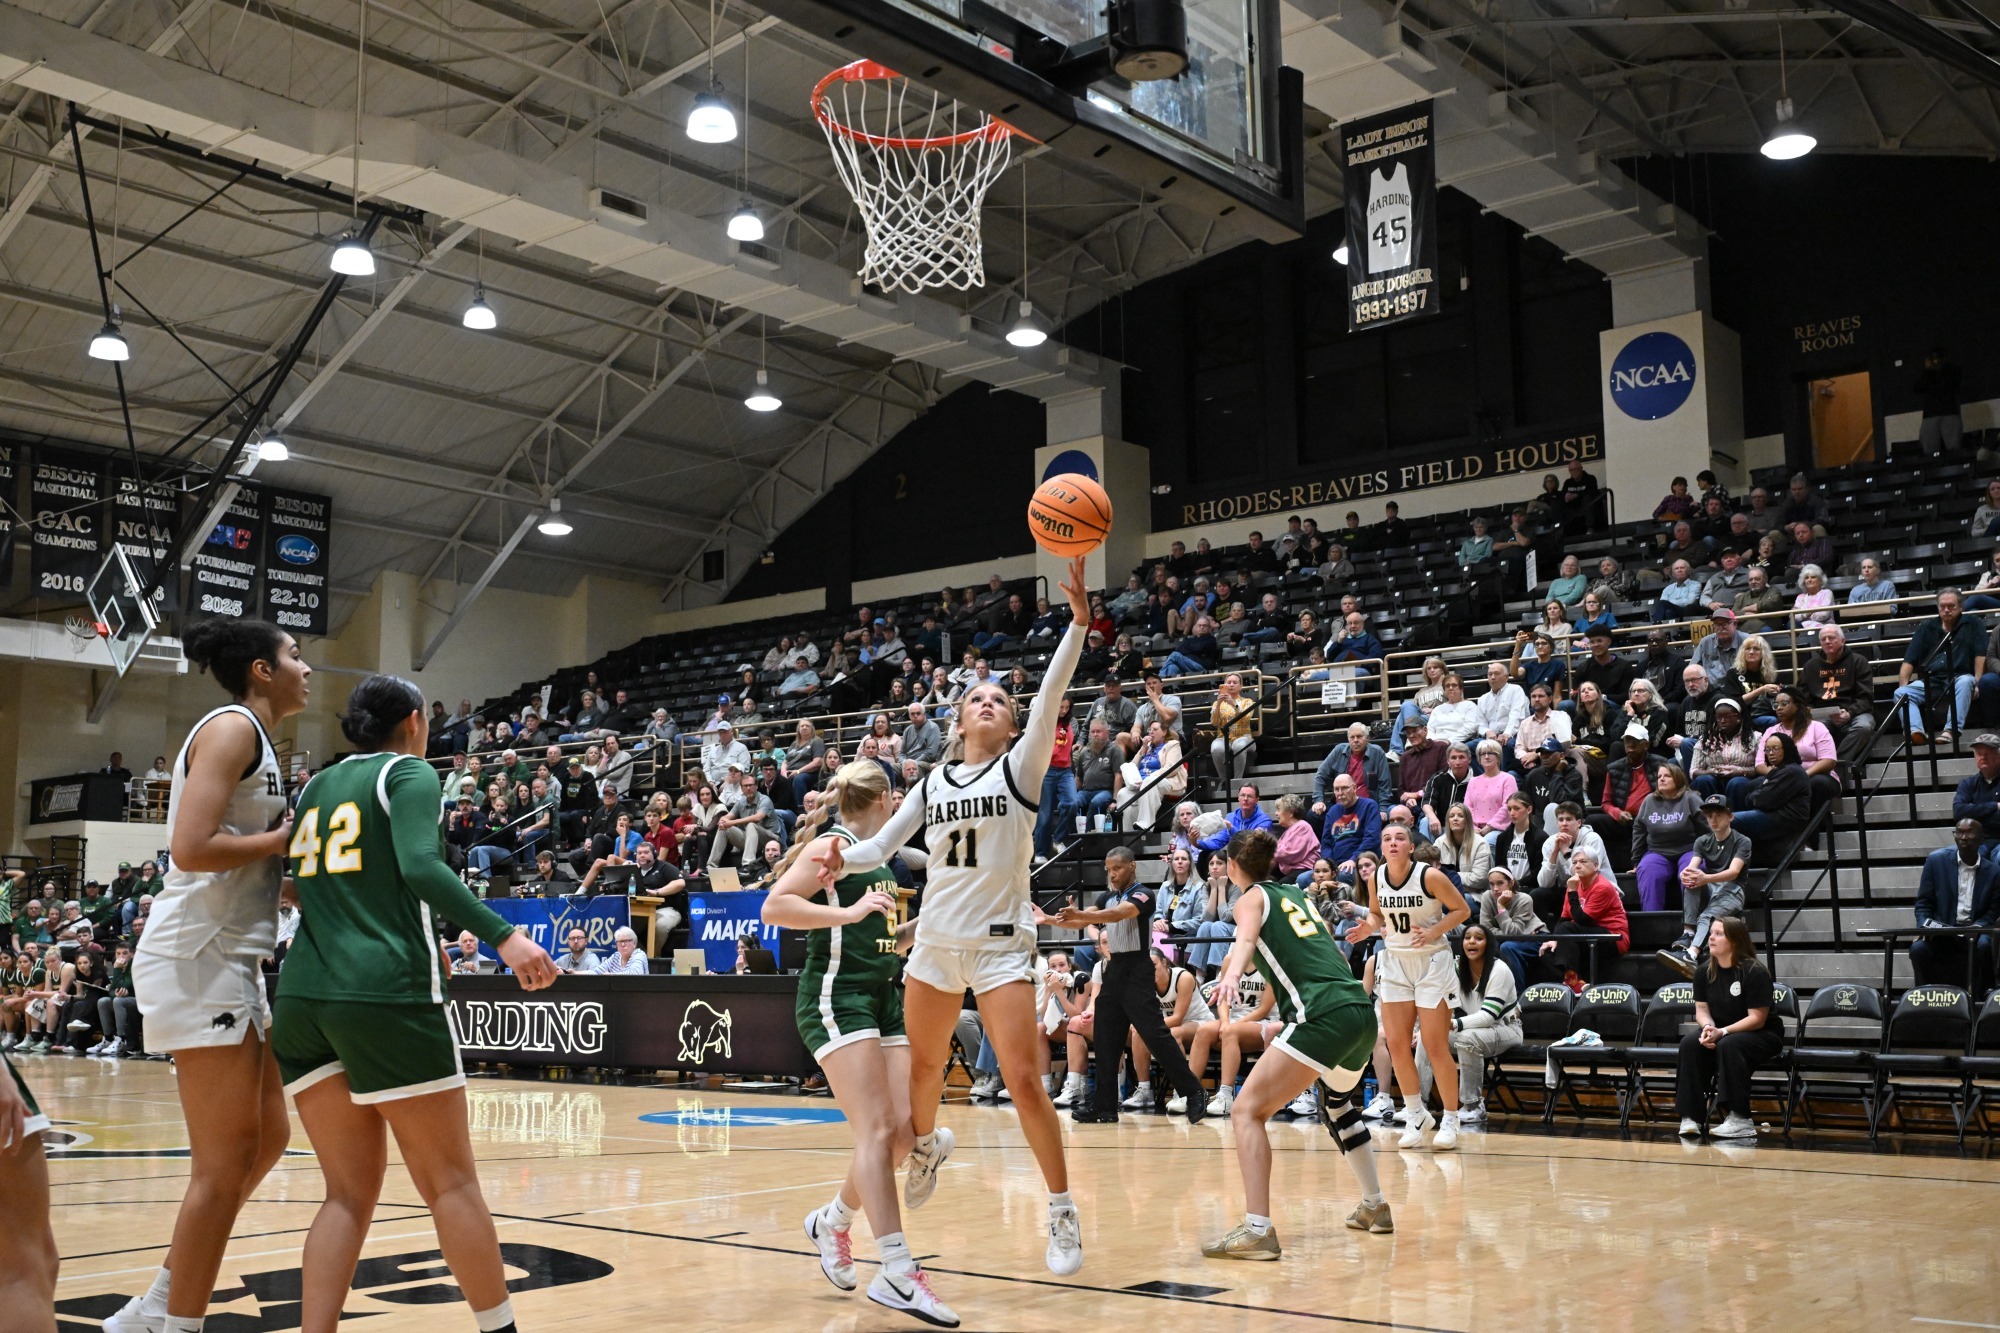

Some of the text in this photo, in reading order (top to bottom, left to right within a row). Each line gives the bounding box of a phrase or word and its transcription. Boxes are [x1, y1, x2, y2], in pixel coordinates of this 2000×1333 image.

[1346, 116, 1429, 151] LADY BISON
[1348, 134, 1427, 167] BASKETBALL
[1369, 193, 1410, 216] HARDING
[1372, 216, 1406, 248] 45
[1351, 268, 1433, 301] ANGIE DUGGER
[1356, 289, 1427, 324] 1993-1997
[1794, 315, 1862, 340] REAVES
[1801, 332, 1855, 353] ROOM
[1614, 360, 1690, 392] NCAA
[37, 464, 97, 487] BISON
[1183, 434, 1599, 526] RHODES-REAVES FIELD HOUSE
[33, 480, 99, 501] BASKETBALL
[275, 496, 325, 516] BISON
[37, 511, 92, 534] GAC
[271, 513, 326, 531] BASKETBALL
[1030, 507, 1075, 538] Wilson
[34, 532, 98, 551] CHAMPIONS
[195, 554, 256, 575] TOURNAMENT
[280, 547, 317, 561] NCAA
[40, 572, 85, 592] 2016
[198, 570, 249, 590] CHAMPIONS
[267, 568, 324, 586] TOURNAMENT
[201, 594, 243, 617] 2025
[270, 588, 320, 608] 22-10
[277, 611, 311, 628] 2025
[927, 795, 1008, 827] HARDING
[1662, 812, 1684, 821] Unity
[289, 801, 362, 877] 42
[946, 829, 977, 867] 11
[1379, 895, 1423, 909] HARDING
[701, 919, 760, 941] MAKE
[1389, 913, 1411, 934] 10
[1539, 988, 1566, 1001] Unity
[1602, 988, 1631, 1002] Unity
[1676, 988, 1694, 999] Uni
[1926, 990, 1961, 1005] Unity
[450, 1001, 608, 1054] ARDING
